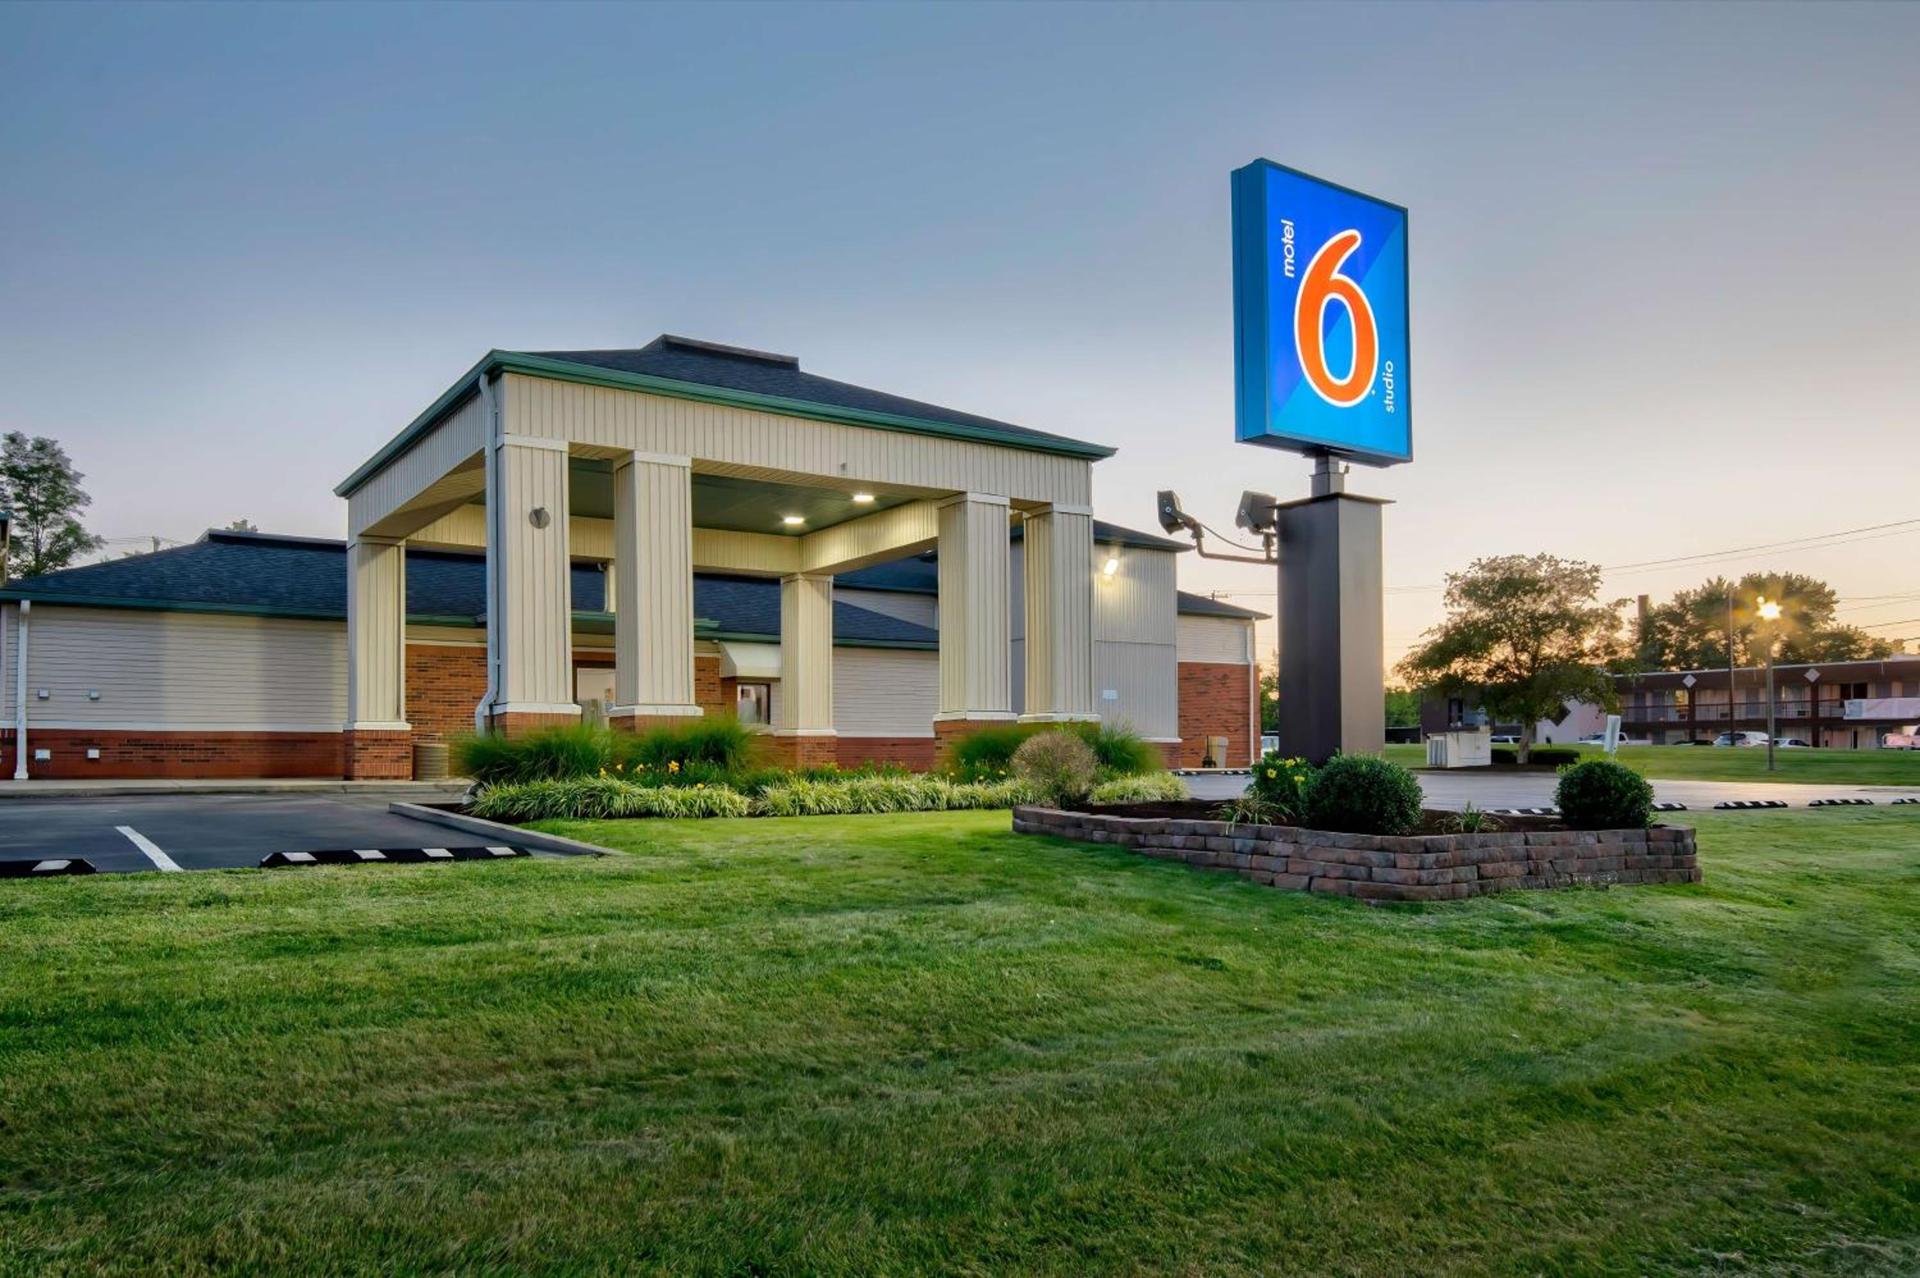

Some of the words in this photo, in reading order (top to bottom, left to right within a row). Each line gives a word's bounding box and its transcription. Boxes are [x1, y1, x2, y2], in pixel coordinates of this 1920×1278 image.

[1281, 219, 1294, 278] motel
[1294, 229, 1379, 407] 6
[1382, 360, 1394, 413] studio
